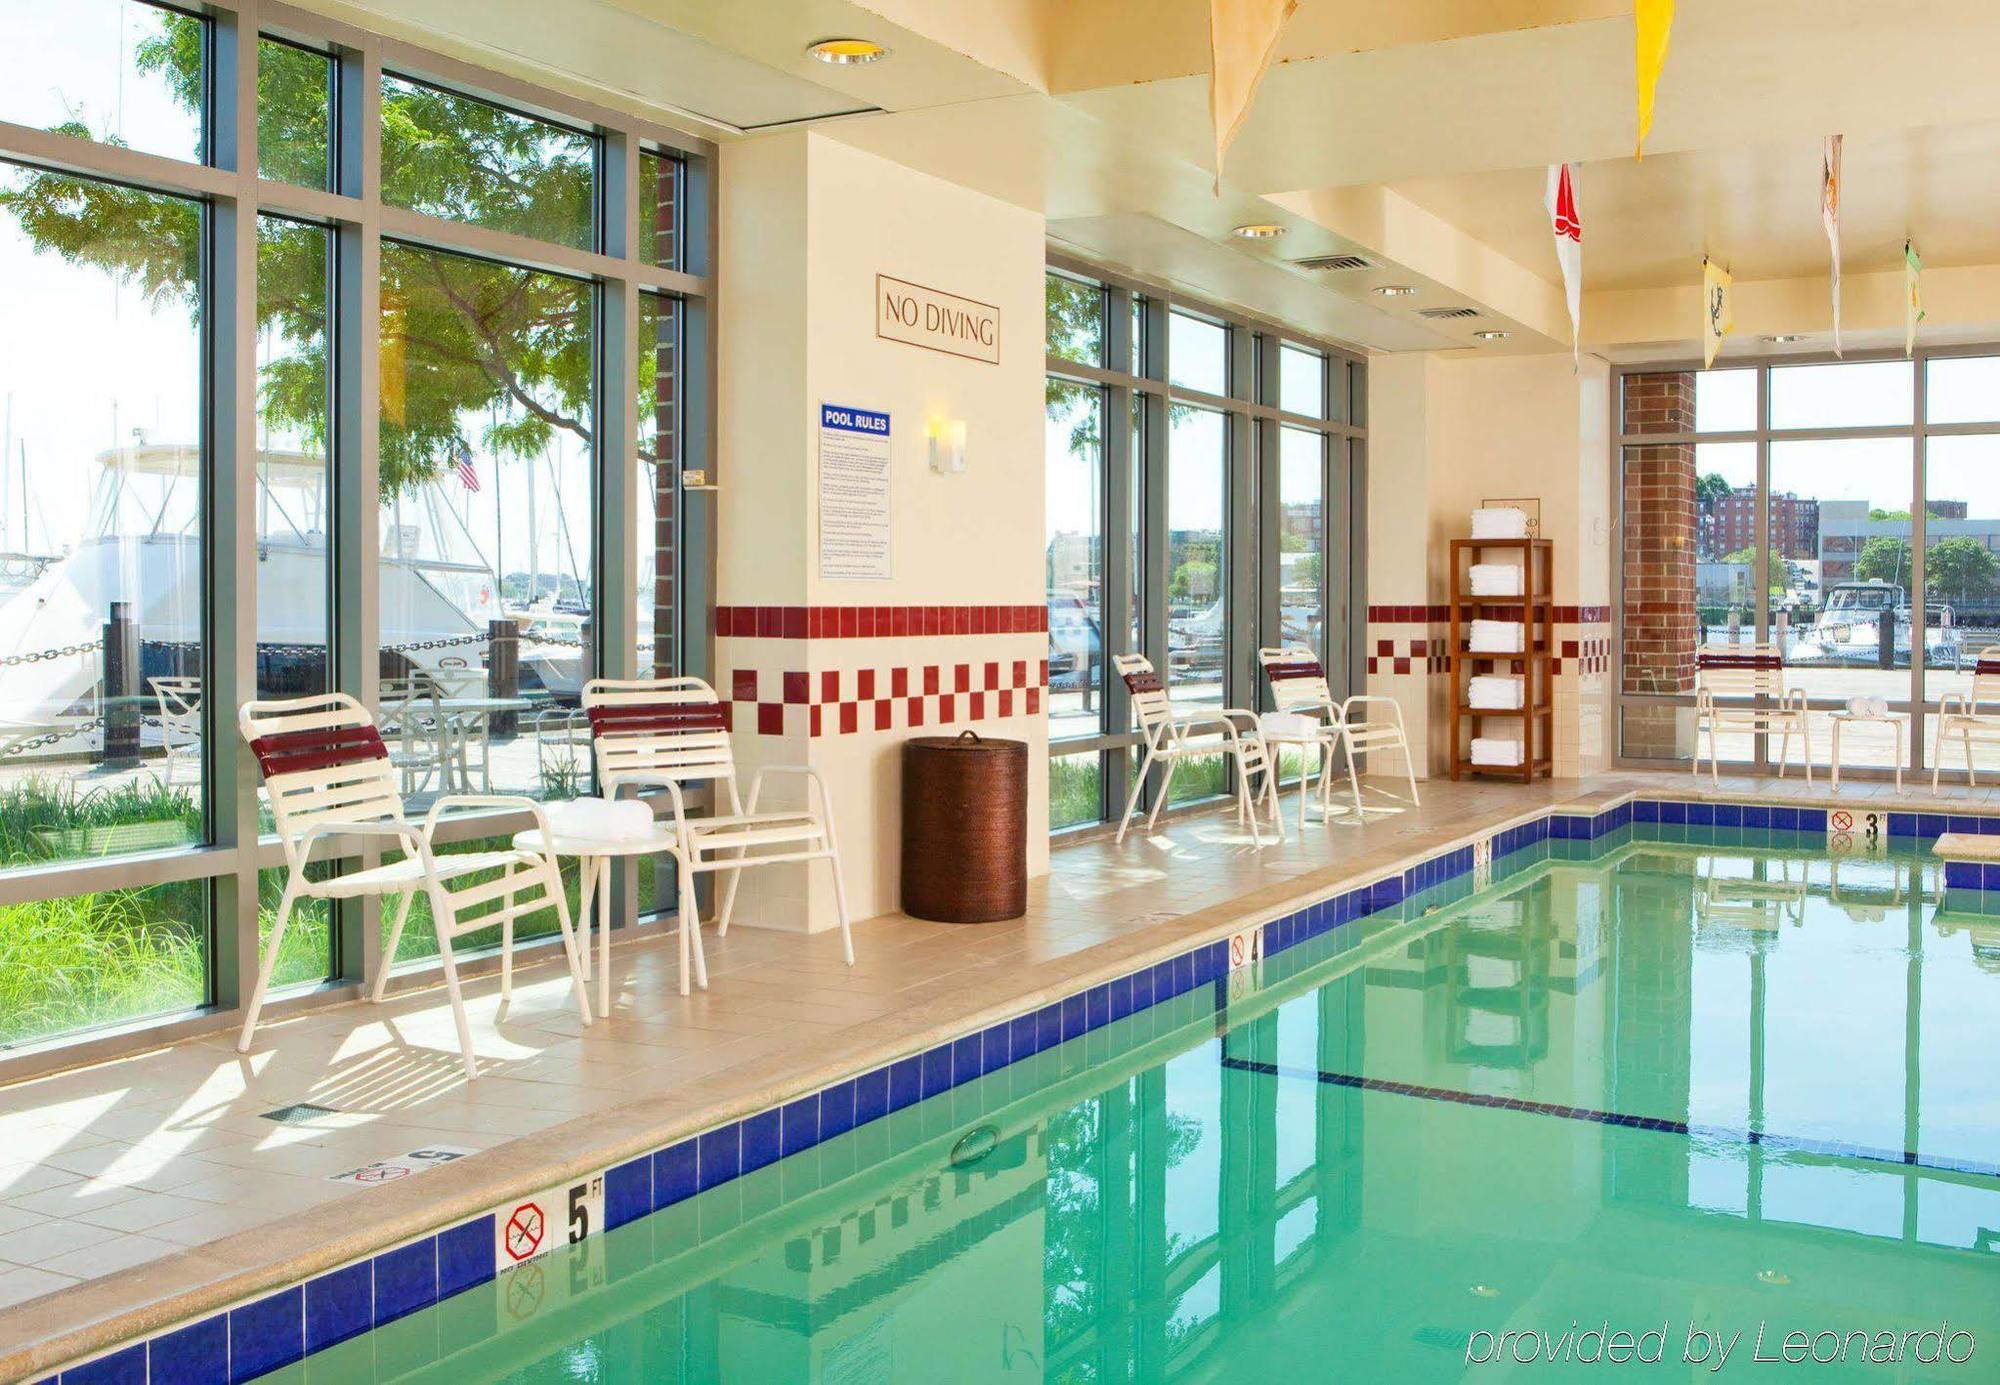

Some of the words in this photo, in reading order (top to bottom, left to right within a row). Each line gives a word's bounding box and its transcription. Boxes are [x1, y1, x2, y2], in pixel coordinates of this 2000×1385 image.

[885, 292, 919, 327] NO
[925, 303, 993, 346] DIVING
[825, 410, 853, 427] POOL
[855, 414, 887, 431] RULES
[1866, 813, 1878, 835] 3
[568, 1183, 589, 1245] 5
[592, 1176, 603, 1199] FT
